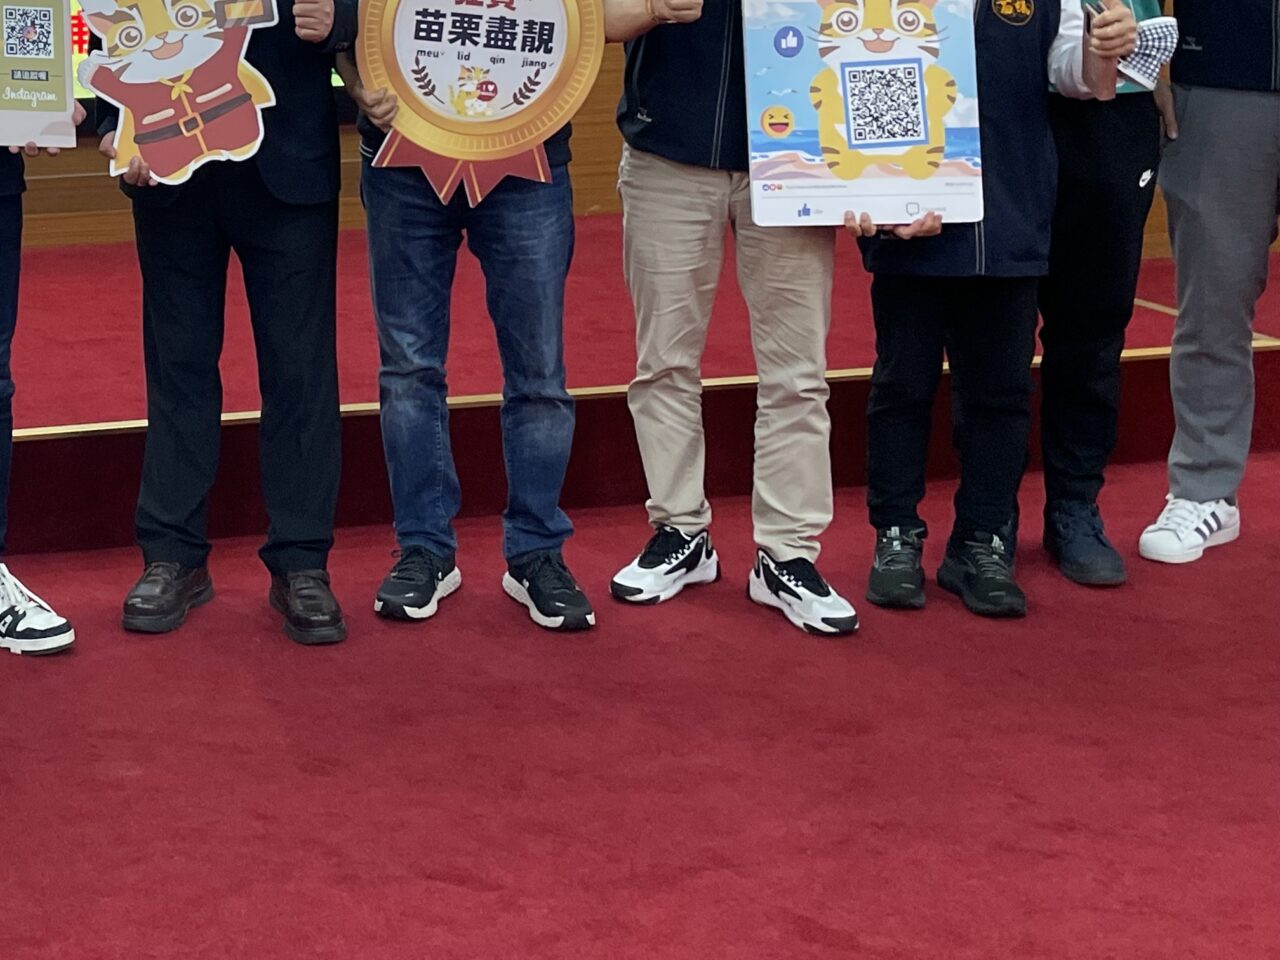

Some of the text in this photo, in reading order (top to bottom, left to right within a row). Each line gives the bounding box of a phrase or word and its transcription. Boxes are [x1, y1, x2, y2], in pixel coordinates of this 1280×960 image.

[414, 8, 556, 55] 苗栗盡靚
[457, 51, 471, 61] lid
[489, 55, 506, 65] qin
[1, 86, 58, 108] Instagram
